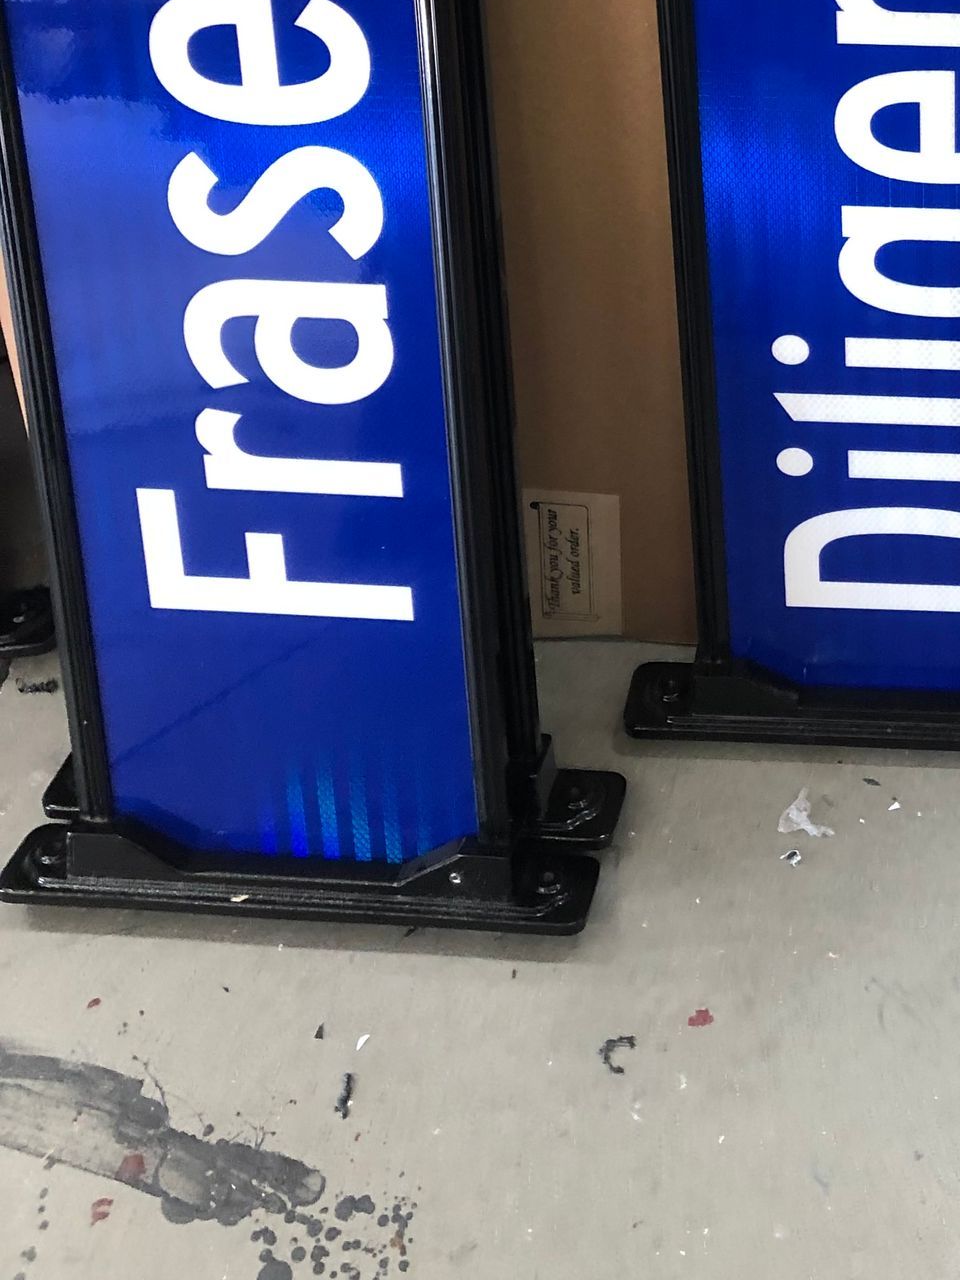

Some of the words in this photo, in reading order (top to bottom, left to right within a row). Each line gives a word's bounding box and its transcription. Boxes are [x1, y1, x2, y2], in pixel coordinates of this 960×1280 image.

[548, 509, 561, 535] your
[544, 535, 562, 555] for
[565, 527, 580, 557] order.
[550, 554, 563, 579] you
[566, 558, 581, 595] valued
[545, 574, 560, 610] Thank
